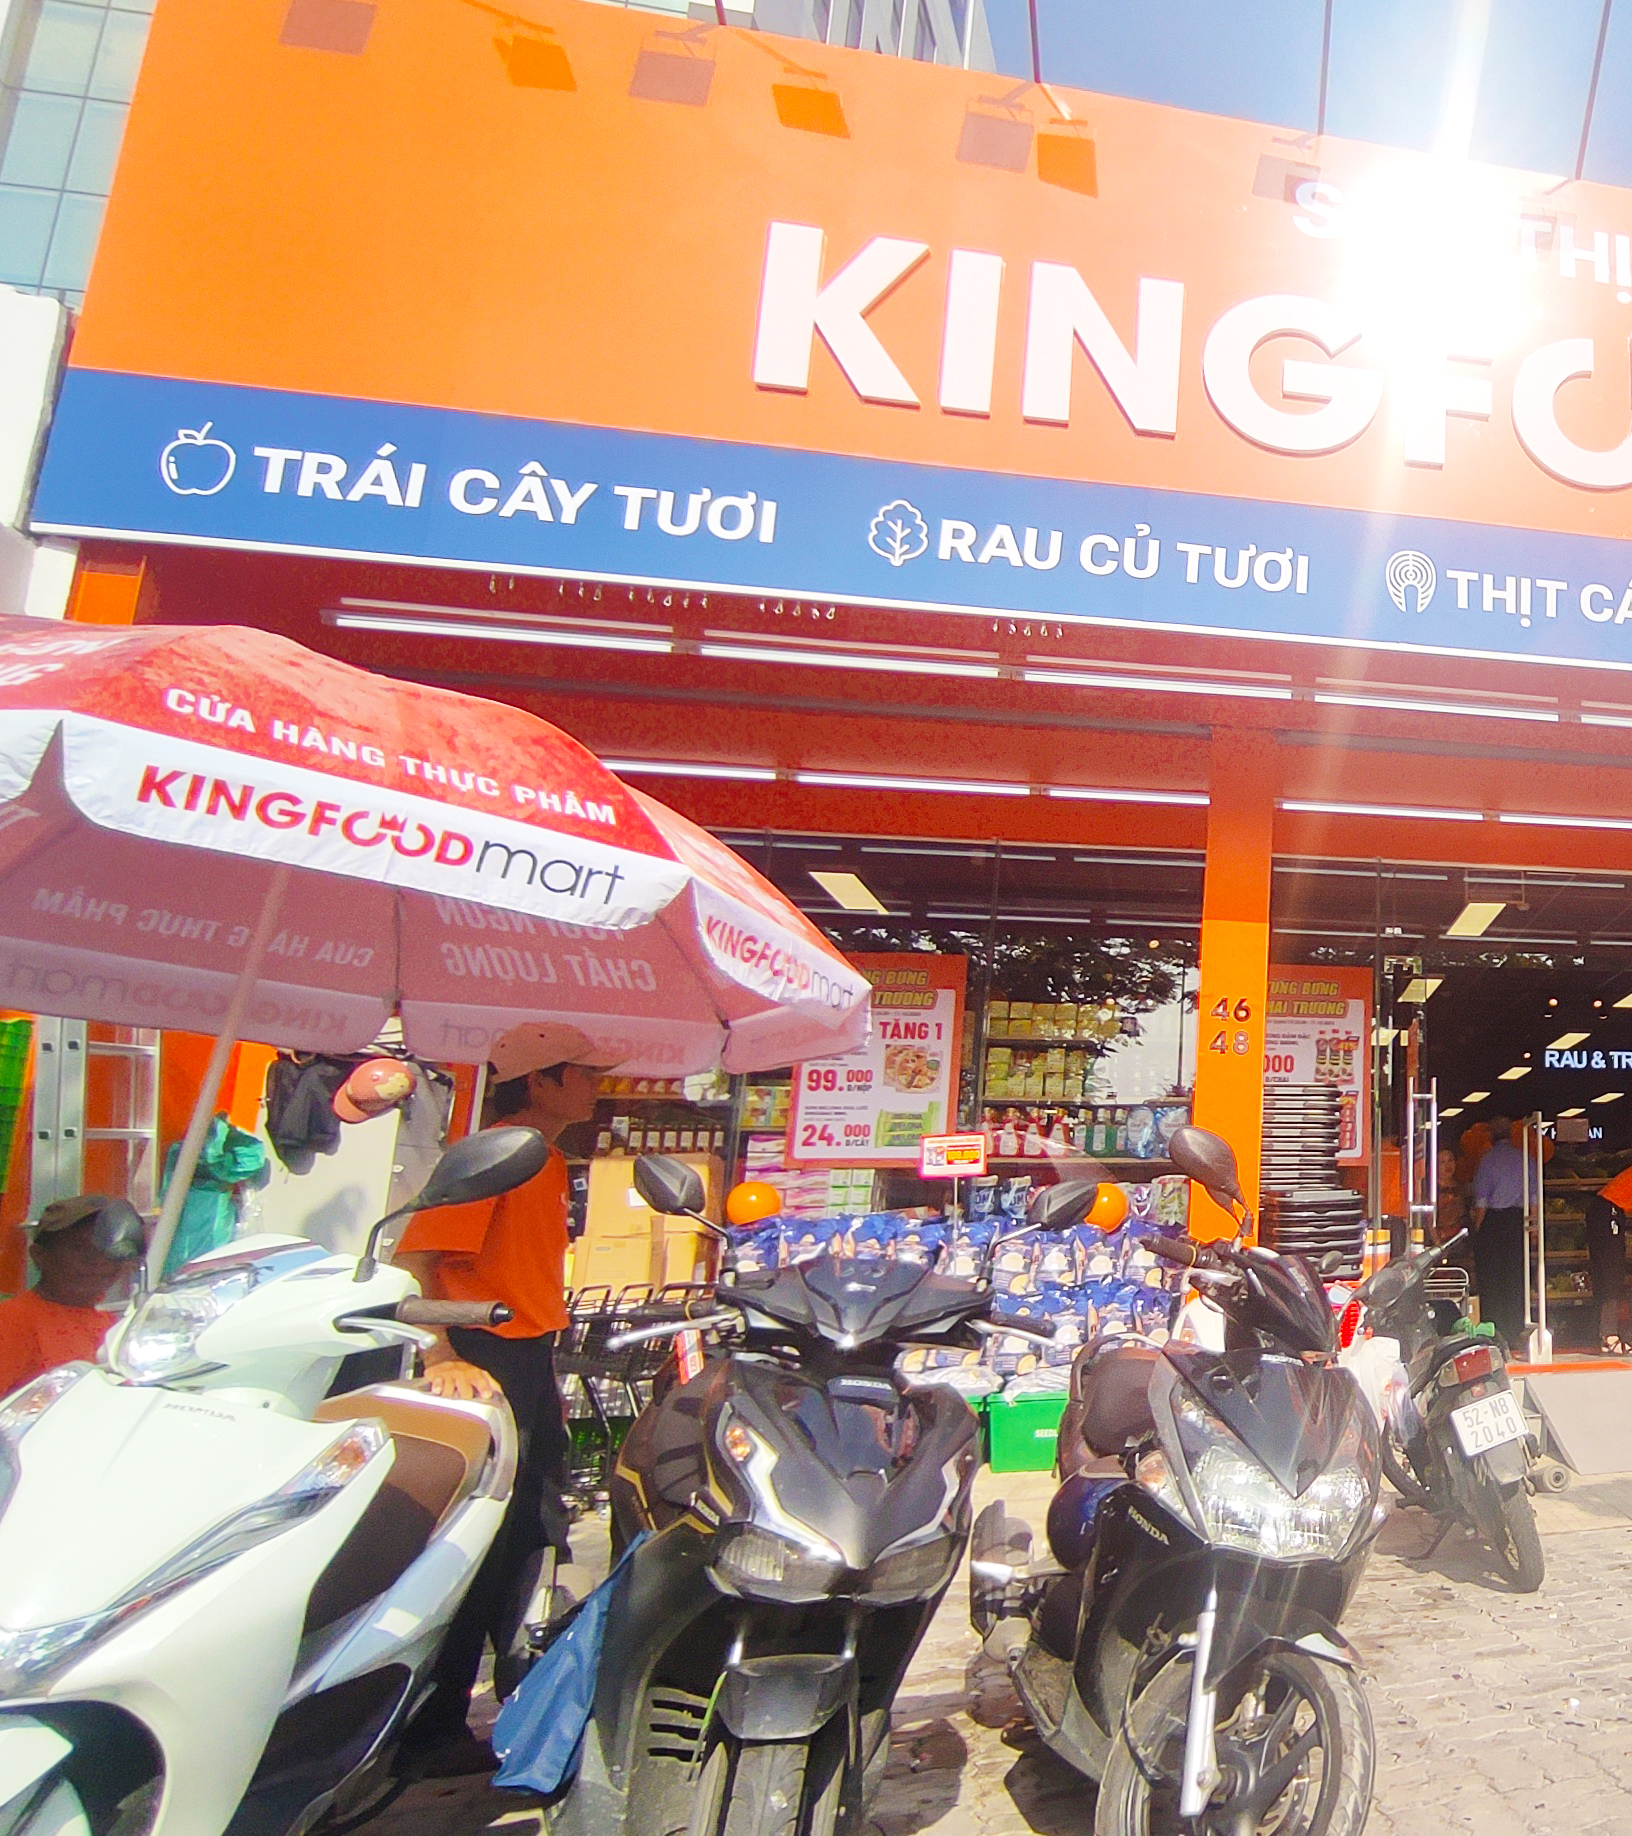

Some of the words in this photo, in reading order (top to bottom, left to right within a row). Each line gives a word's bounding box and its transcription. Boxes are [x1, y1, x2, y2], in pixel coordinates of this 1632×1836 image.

[252, 442, 427, 508] TRÁI
[448, 460, 598, 526] CÂY
[613, 484, 778, 544] TƯƠI
[937, 517, 1063, 571] RAU
[1078, 523, 1160, 580] CỦ
[1176, 541, 1310, 595] TƯƠI
[1446, 568, 1568, 630] THỊT
[166, 687, 256, 734] CỬA
[273, 716, 386, 768] HÀNG
[399, 755, 500, 797] THỰC
[515, 779, 618, 827] PHẨM
[1210, 998, 1251, 1022] 46
[935, 1022, 943, 1040] 1
[1209, 1031, 1249, 1055] 48
[1545, 1050, 1587, 1068] RAU
[1591, 1051, 1606, 1068] &
[1471, 1416, 1517, 1448] 2040
[1128, 1505, 1170, 1546] HONDA
